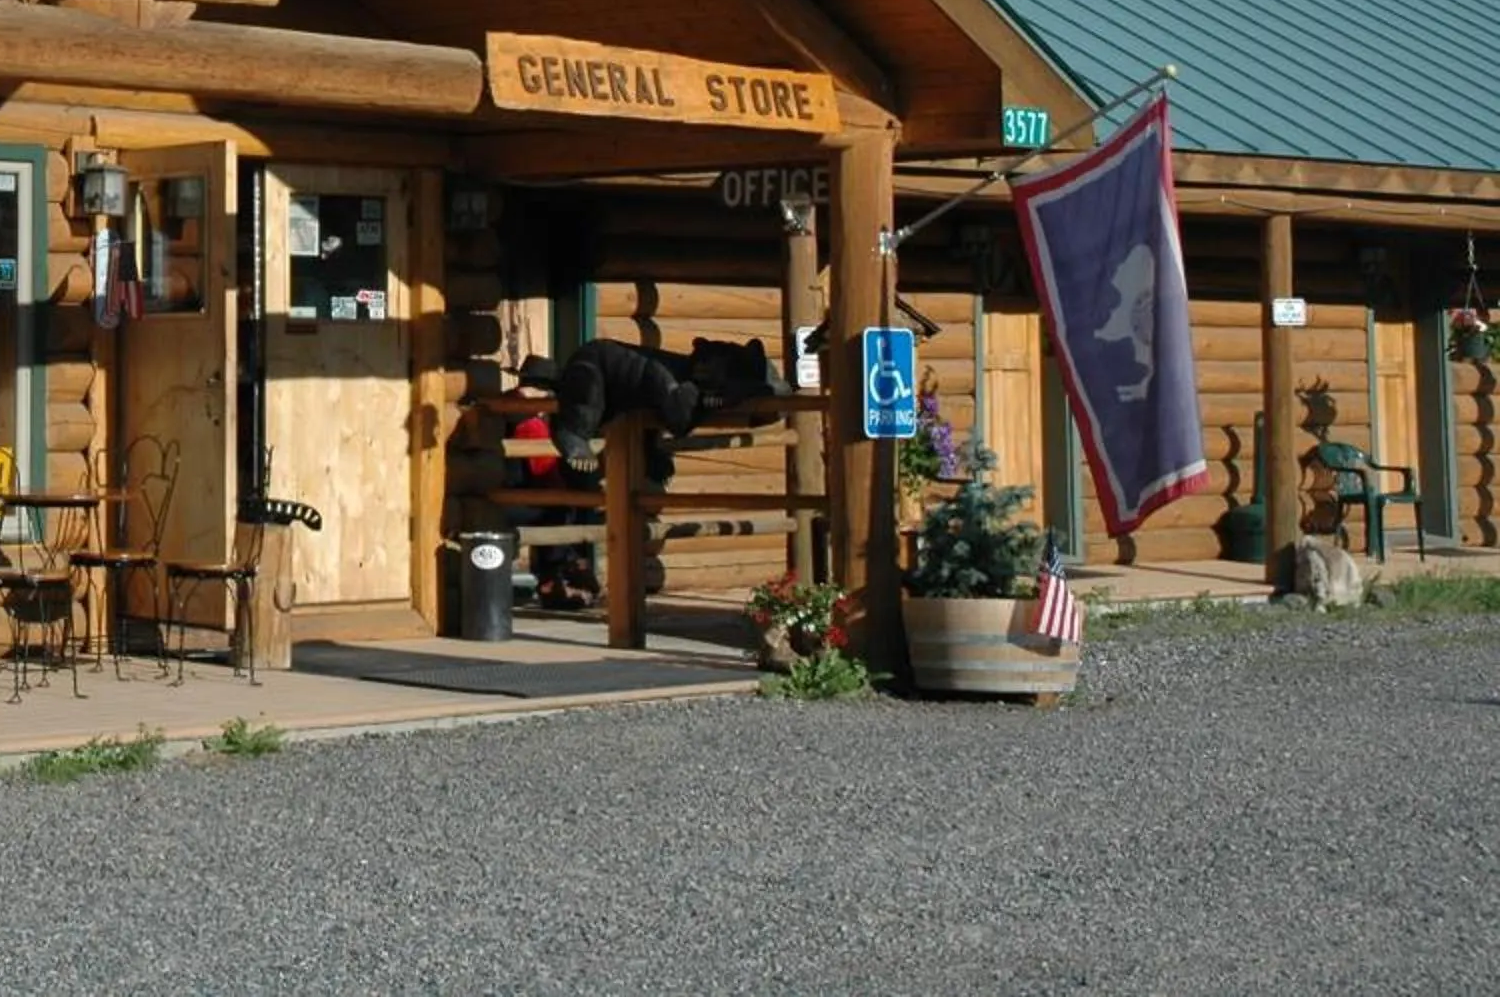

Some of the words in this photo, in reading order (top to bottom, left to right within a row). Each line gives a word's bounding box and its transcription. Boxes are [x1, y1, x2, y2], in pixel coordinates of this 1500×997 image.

[517, 55, 675, 108] GENERAL
[705, 74, 815, 121] STORE
[1004, 108, 1048, 146] 3577
[722, 167, 831, 209] OFFICE
[869, 409, 913, 426] PARKING
